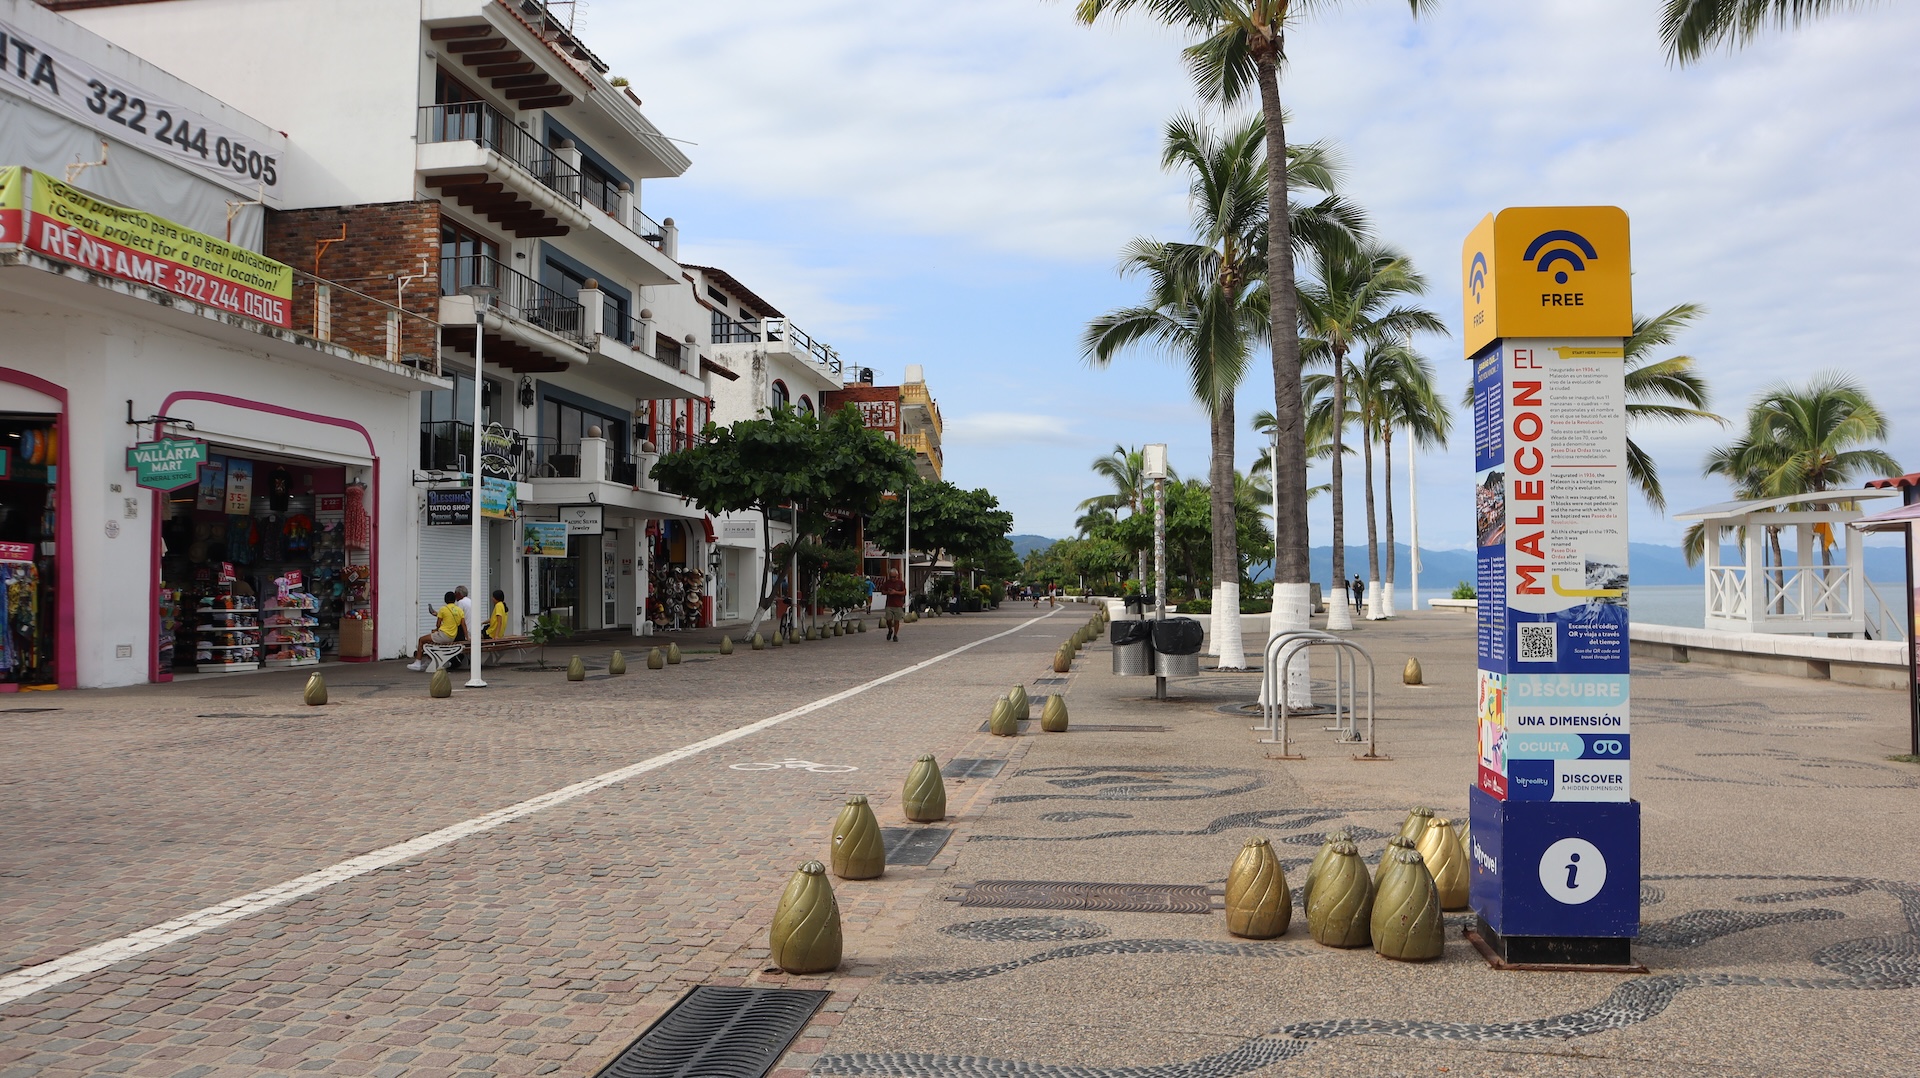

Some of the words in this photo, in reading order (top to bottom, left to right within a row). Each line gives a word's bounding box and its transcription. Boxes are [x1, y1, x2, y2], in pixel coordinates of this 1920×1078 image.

[86, 79, 147, 134] 322
[155, 110, 208, 159] 244
[216, 136, 276, 186] 0505
[90, 201, 148, 229] proyecto
[151, 222, 177, 240] para
[181, 233, 202, 248] una
[205, 242, 229, 257] gran
[232, 249, 283, 276] ubicación!
[104, 225, 154, 251] project
[155, 240, 178, 256] for
[181, 251, 189, 261] a
[192, 254, 224, 274] great
[227, 264, 278, 292] location!
[41, 220, 169, 290] RÉNTAME
[174, 268, 206, 301] 322
[210, 280, 240, 312] 244
[244, 290, 283, 324] 0505
[1542, 293, 1584, 306] FREE
[1474, 310, 1484, 328] FREE
[1514, 350, 1542, 369] EL
[134, 447, 200, 463] VALLARTA
[152, 461, 182, 472] MART
[1512, 381, 1545, 595] MALECON
[429, 491, 471, 504] BLESSINGS
[1519, 683, 1620, 697] DESCUBRE
[1518, 717, 1545, 726] UNA
[1550, 713, 1621, 726] DIMENSIÓN
[1519, 742, 1569, 752] OCULTA
[1562, 775, 1622, 784] DISCOVER
